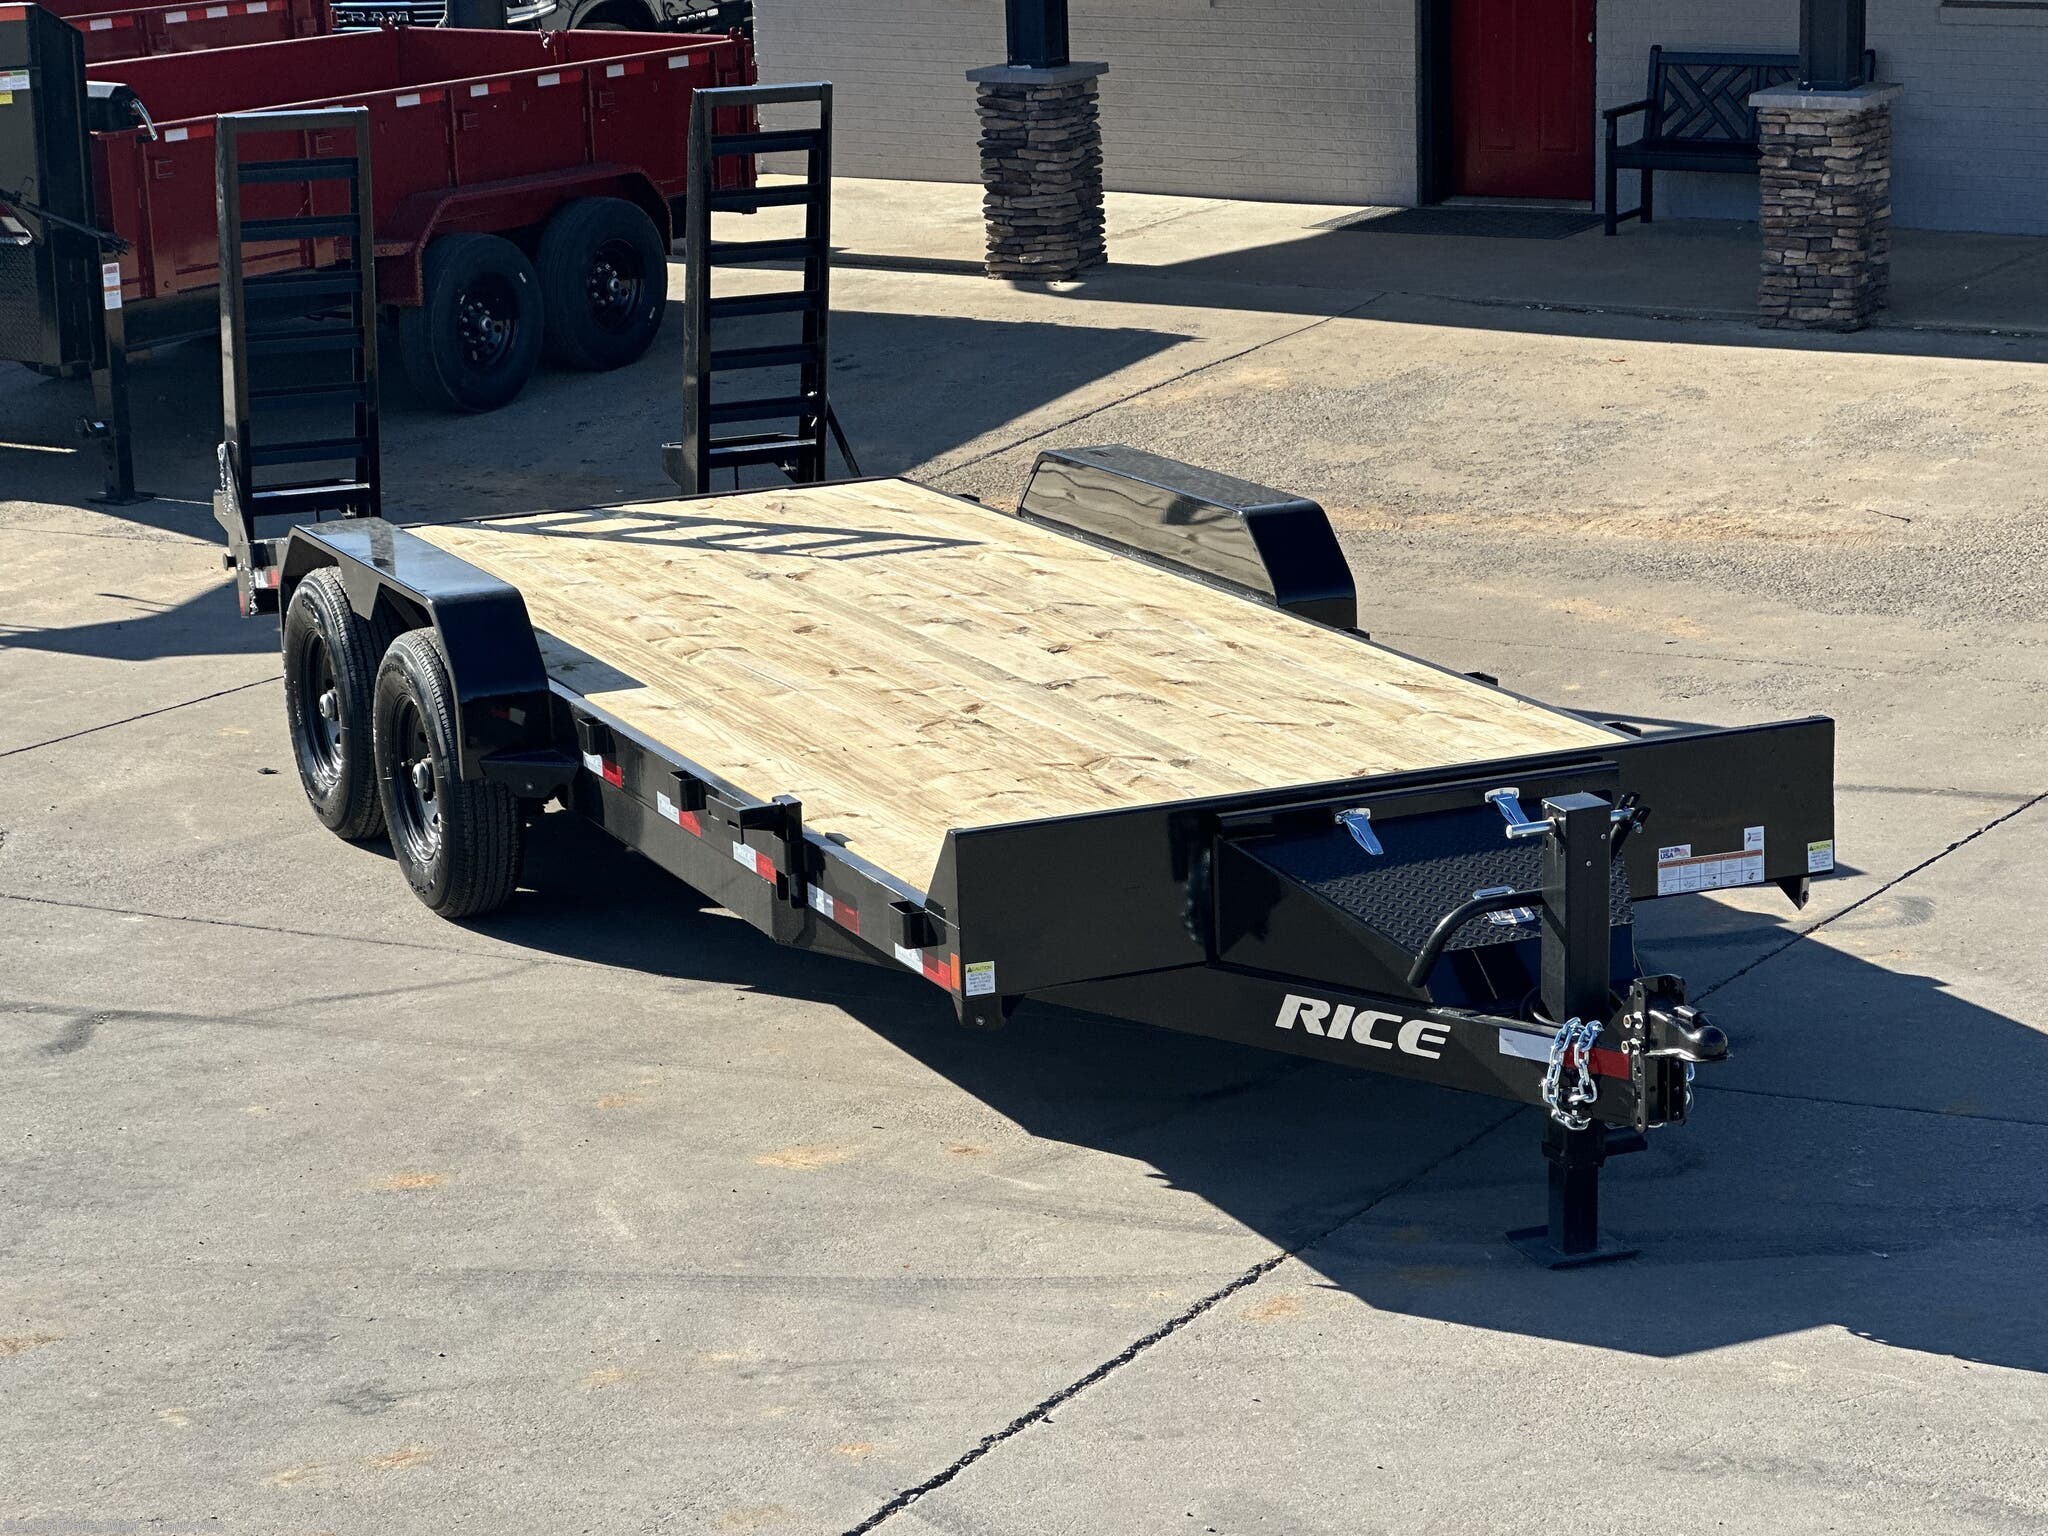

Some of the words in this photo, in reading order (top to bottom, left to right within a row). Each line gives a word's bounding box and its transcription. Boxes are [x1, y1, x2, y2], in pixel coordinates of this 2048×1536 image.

[345, 11, 410, 22] RAM
[1660, 852, 1674, 860] USA
[1275, 993, 1450, 1059] RICE
